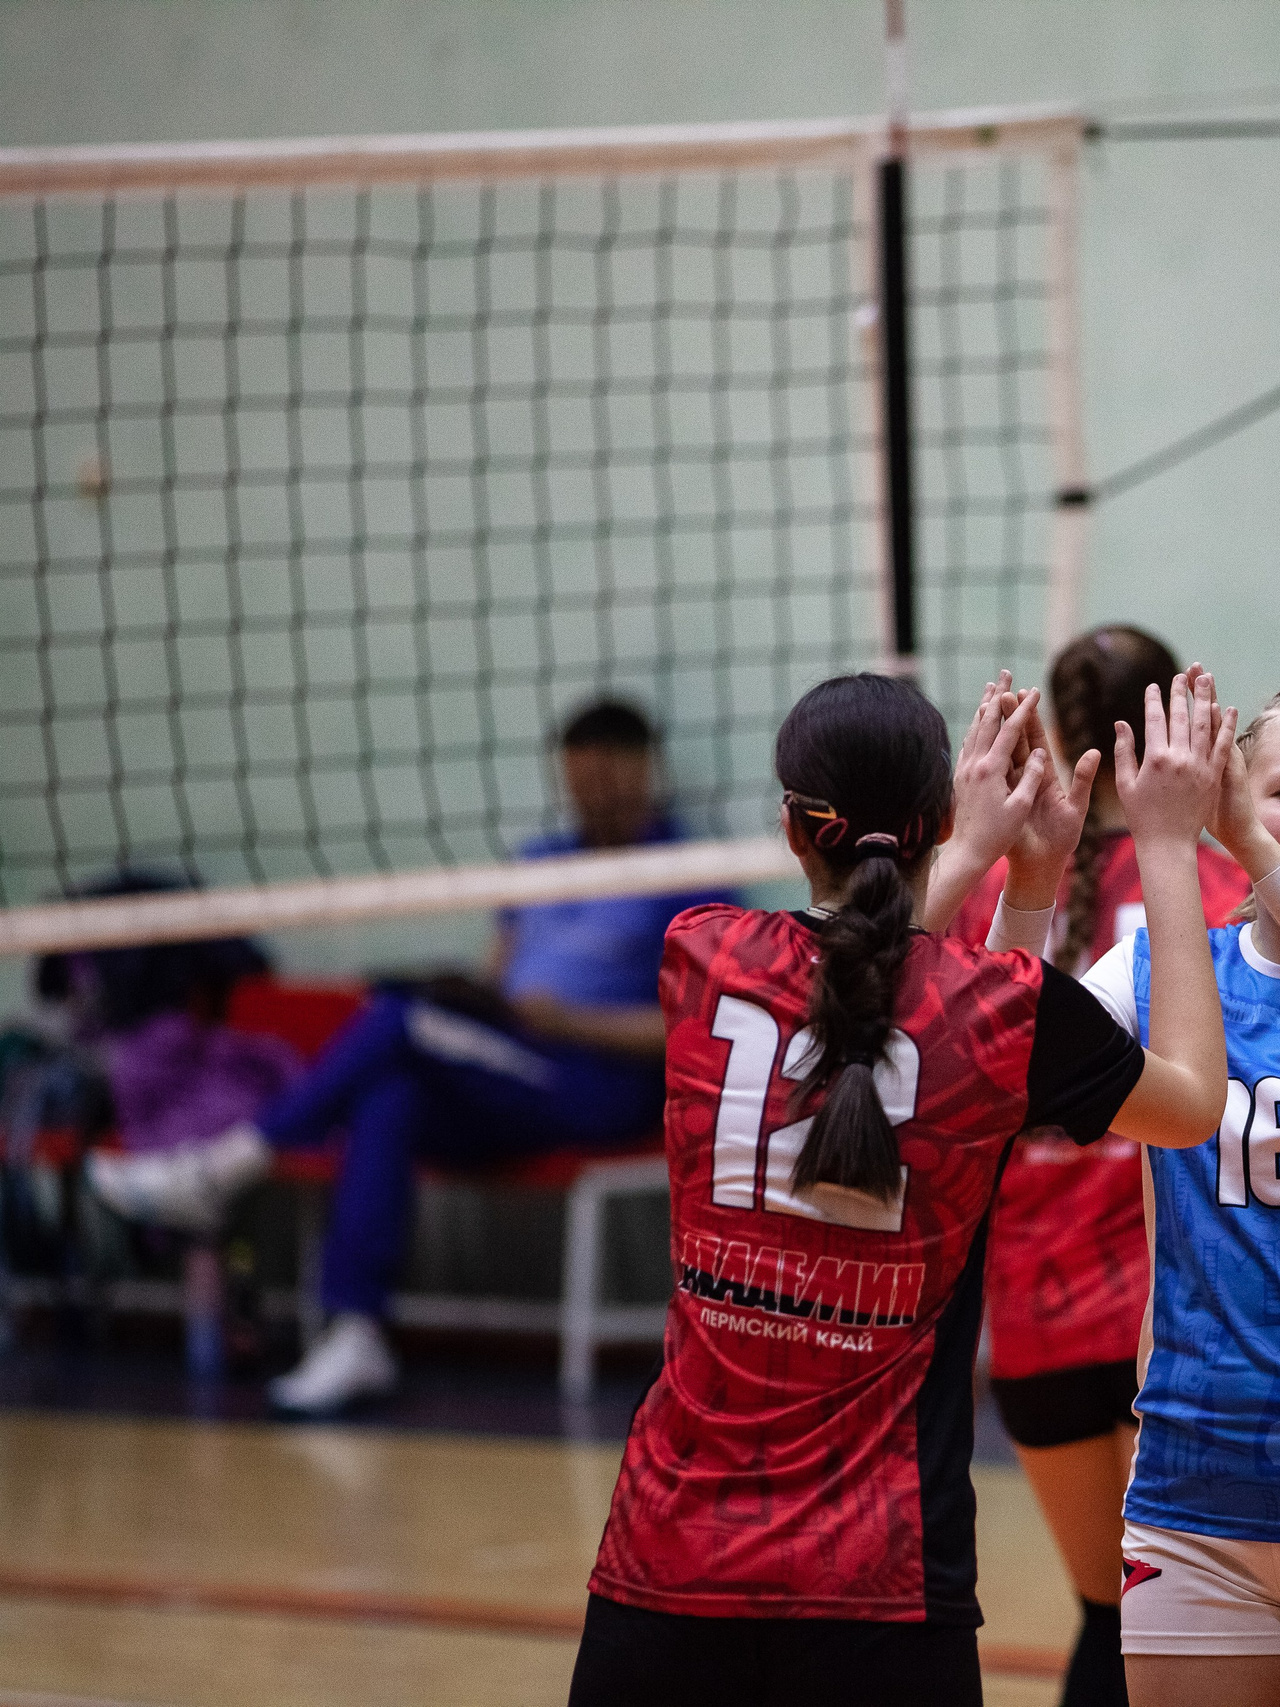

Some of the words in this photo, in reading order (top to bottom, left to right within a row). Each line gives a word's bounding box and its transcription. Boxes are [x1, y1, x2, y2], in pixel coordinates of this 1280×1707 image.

[710, 993, 921, 1232] 12
[700, 1306, 808, 1343] ПЕРМСКИЙ
[815, 1330, 874, 1352] КРАЙ
